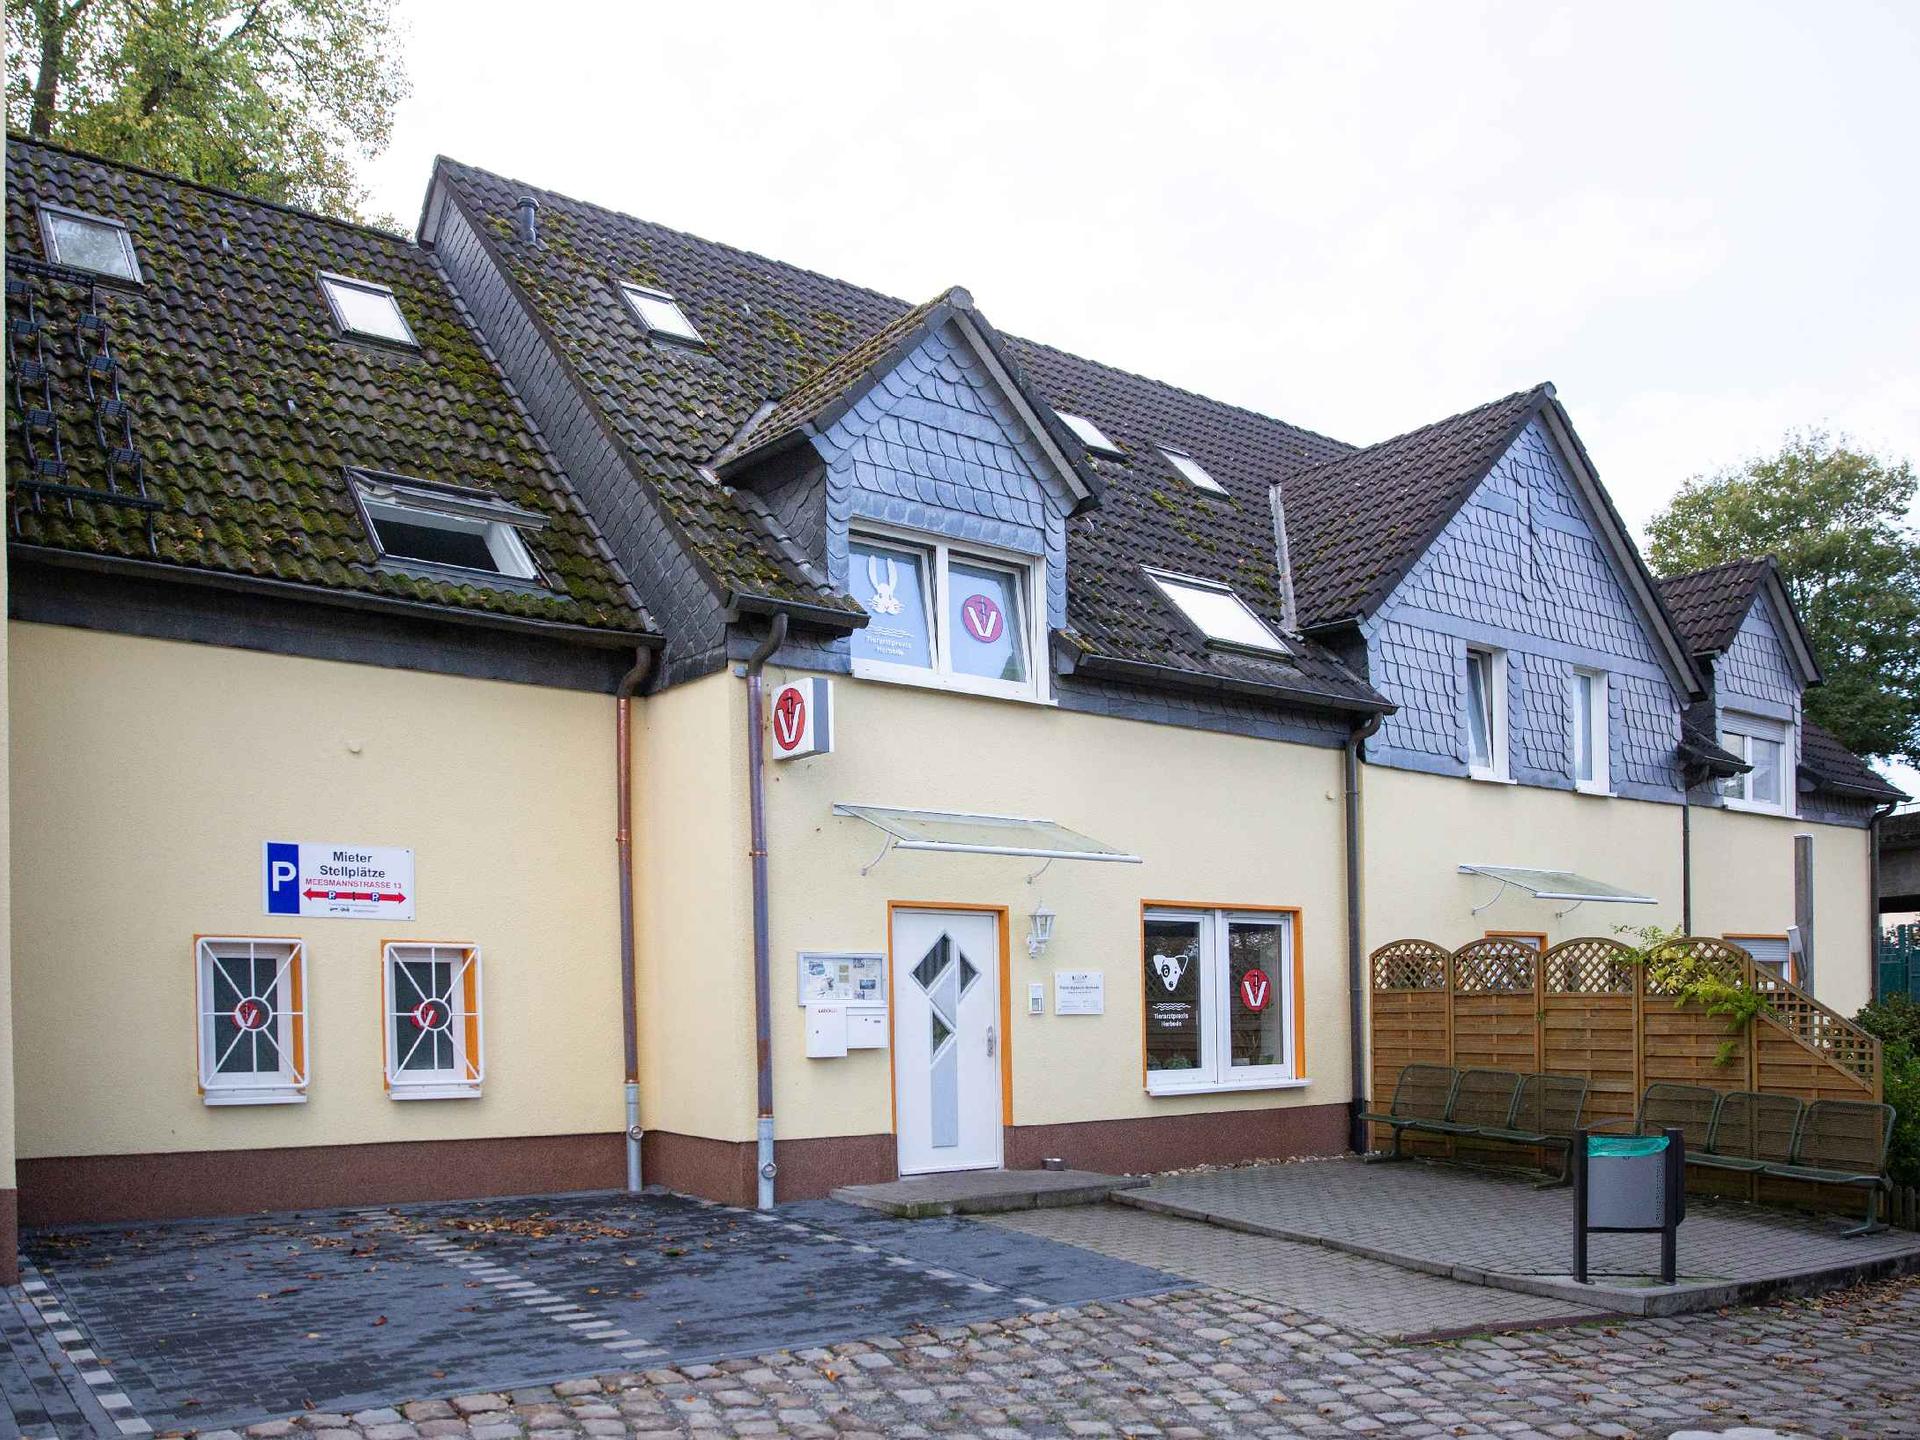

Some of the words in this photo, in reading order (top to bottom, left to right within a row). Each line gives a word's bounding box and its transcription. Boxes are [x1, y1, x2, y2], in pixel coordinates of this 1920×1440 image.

[333, 851, 373, 863] Mieter
[272, 861, 297, 892] P
[320, 865, 386, 879] Stellplätze
